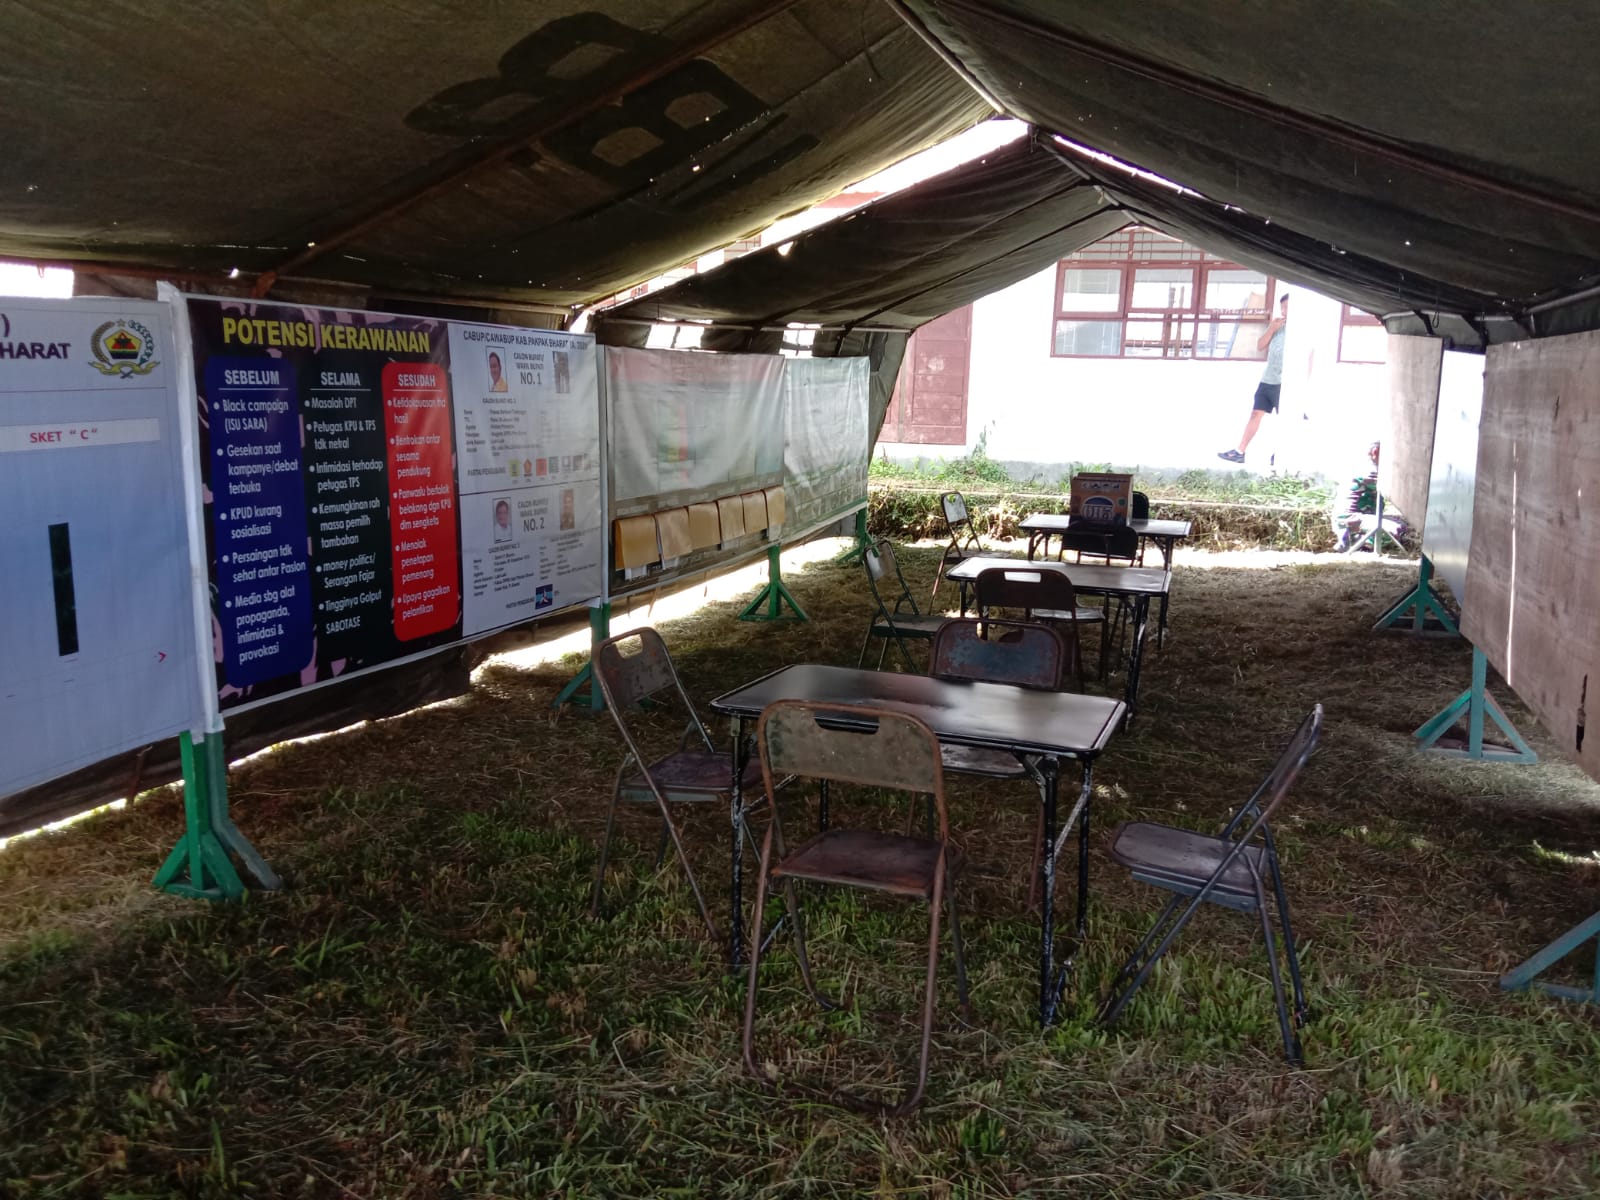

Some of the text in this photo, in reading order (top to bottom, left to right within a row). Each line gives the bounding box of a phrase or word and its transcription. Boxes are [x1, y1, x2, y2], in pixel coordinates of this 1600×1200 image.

[223, 317, 430, 353] POTENSI KERAWANAN
[224, 370, 280, 385] SEBELUM
[320, 371, 361, 386] SELAMA
[398, 373, 436, 387] SESUDAH
[520, 372, 543, 385] NO. 1
[222, 399, 289, 414] Black campaign
[311, 397, 357, 409] Masalah DPT
[225, 417, 268, 434] (ISU SARA)
[313, 420, 377, 435] Petugas KPU & TPS
[30, 431, 63, 443] SKET
[328, 437, 350, 449] netral
[227, 442, 281, 457] Gesekan saat
[316, 459, 383, 474] Intimidasi terhadap
[228, 480, 261, 495] terbuka
[317, 476, 360, 493] petugas TPS
[230, 505, 282, 520] KPUD kurang
[319, 499, 368, 514] Kemungkinan
[399, 502, 428, 515] belakang
[428, 501, 440, 513] dgn
[320, 514, 371, 531] massa pemilih
[523, 517, 545, 532] NO. 2
[231, 522, 272, 539] sosialisasi
[321, 534, 359, 549] tambahan
[400, 538, 427, 552] Menolak
[232, 548, 279, 564] Persaingan
[401, 553, 434, 569] penetapan
[233, 560, 306, 583] sehat antar Paslon
[323, 559, 349, 572] money
[324, 570, 375, 588] Serangan Fajar
[402, 568, 434, 584] pemenang
[235, 585, 295, 608] Media sbg alat
[325, 588, 382, 612] Tingginya Golput
[326, 615, 361, 634] SABOTASE
[237, 624, 285, 644] intimidasi &
[239, 641, 280, 665] provokasi
